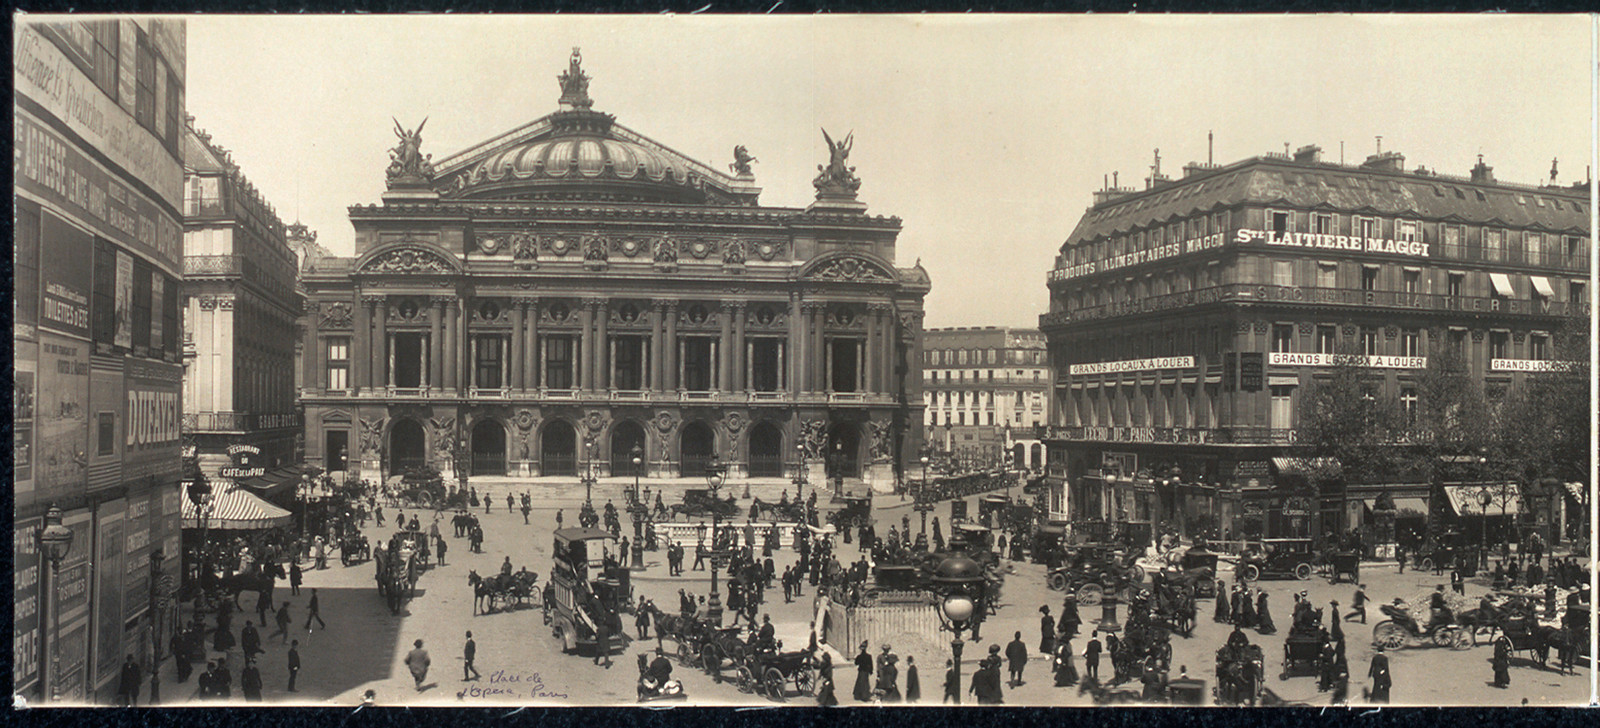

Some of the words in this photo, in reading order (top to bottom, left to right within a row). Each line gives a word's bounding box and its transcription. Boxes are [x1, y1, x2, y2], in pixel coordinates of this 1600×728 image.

[1266, 230, 1362, 250] LAITIERE
[1367, 238, 1429, 257] MAGGI
[1053, 262, 1096, 281] PRODUITS
[1104, 243, 1180, 271] ALIMENTAIRES
[1186, 233, 1225, 254] MAGGI
[44, 297, 74, 324] TOILETTES
[1073, 361, 1108, 373] GRANDS
[1110, 359, 1146, 372] LOCAUX
[1148, 359, 1158, 368] A
[1158, 357, 1190, 369] LOUER
[1273, 354, 1320, 364] GRANDS
[1376, 357, 1384, 366] A
[1388, 357, 1424, 368] LOUER
[1493, 360, 1530, 370] GRANDS
[127, 390, 180, 446] DUFAYEL
[1113, 427, 1125, 442] DE
[1130, 427, 1155, 442] PARIS
[229, 445, 260, 455] RESTAURANT
